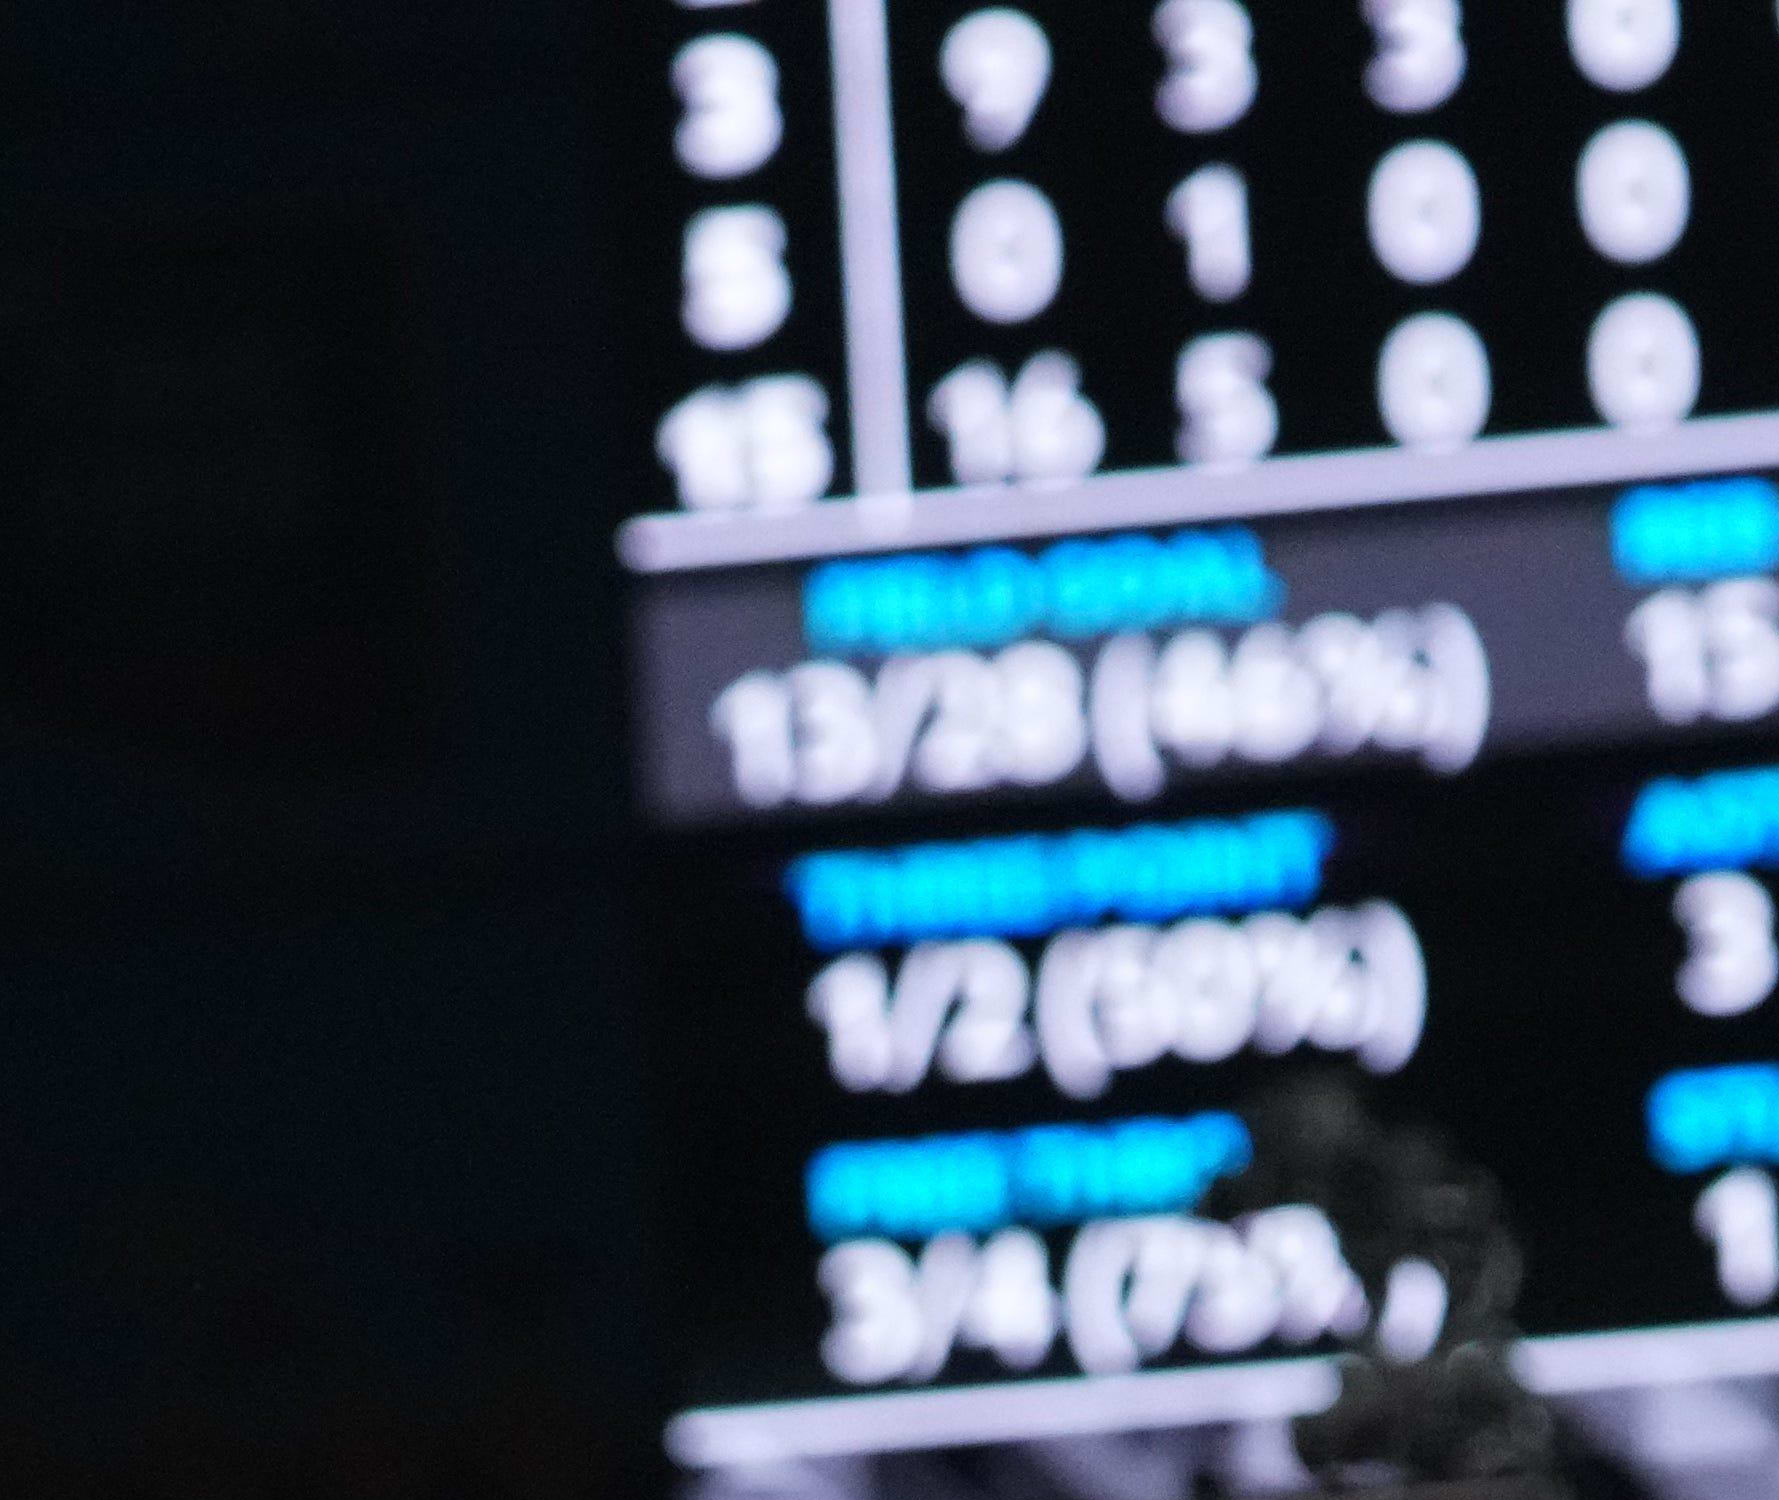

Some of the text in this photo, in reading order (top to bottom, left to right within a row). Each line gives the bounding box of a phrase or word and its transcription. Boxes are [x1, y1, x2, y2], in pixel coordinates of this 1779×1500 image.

[675, 35, 782, 177] 3
[943, 10, 1049, 145] 9
[1160, 0, 1254, 131] 3
[685, 207, 790, 349] 5
[952, 182, 1062, 322] 0
[1172, 167, 1249, 300] 1
[1368, 142, 1479, 283] 0
[1578, 123, 1689, 262] 0
[660, 377, 832, 508] 15
[933, 352, 1104, 484] 16
[1178, 335, 1276, 463] 5
[1379, 315, 1490, 448] 0
[1589, 295, 1699, 428] 0
[808, 940, 1035, 1094] 1/2
[1675, 870, 1779, 1020] 3
[820, 1234, 1058, 1383] 3/4
